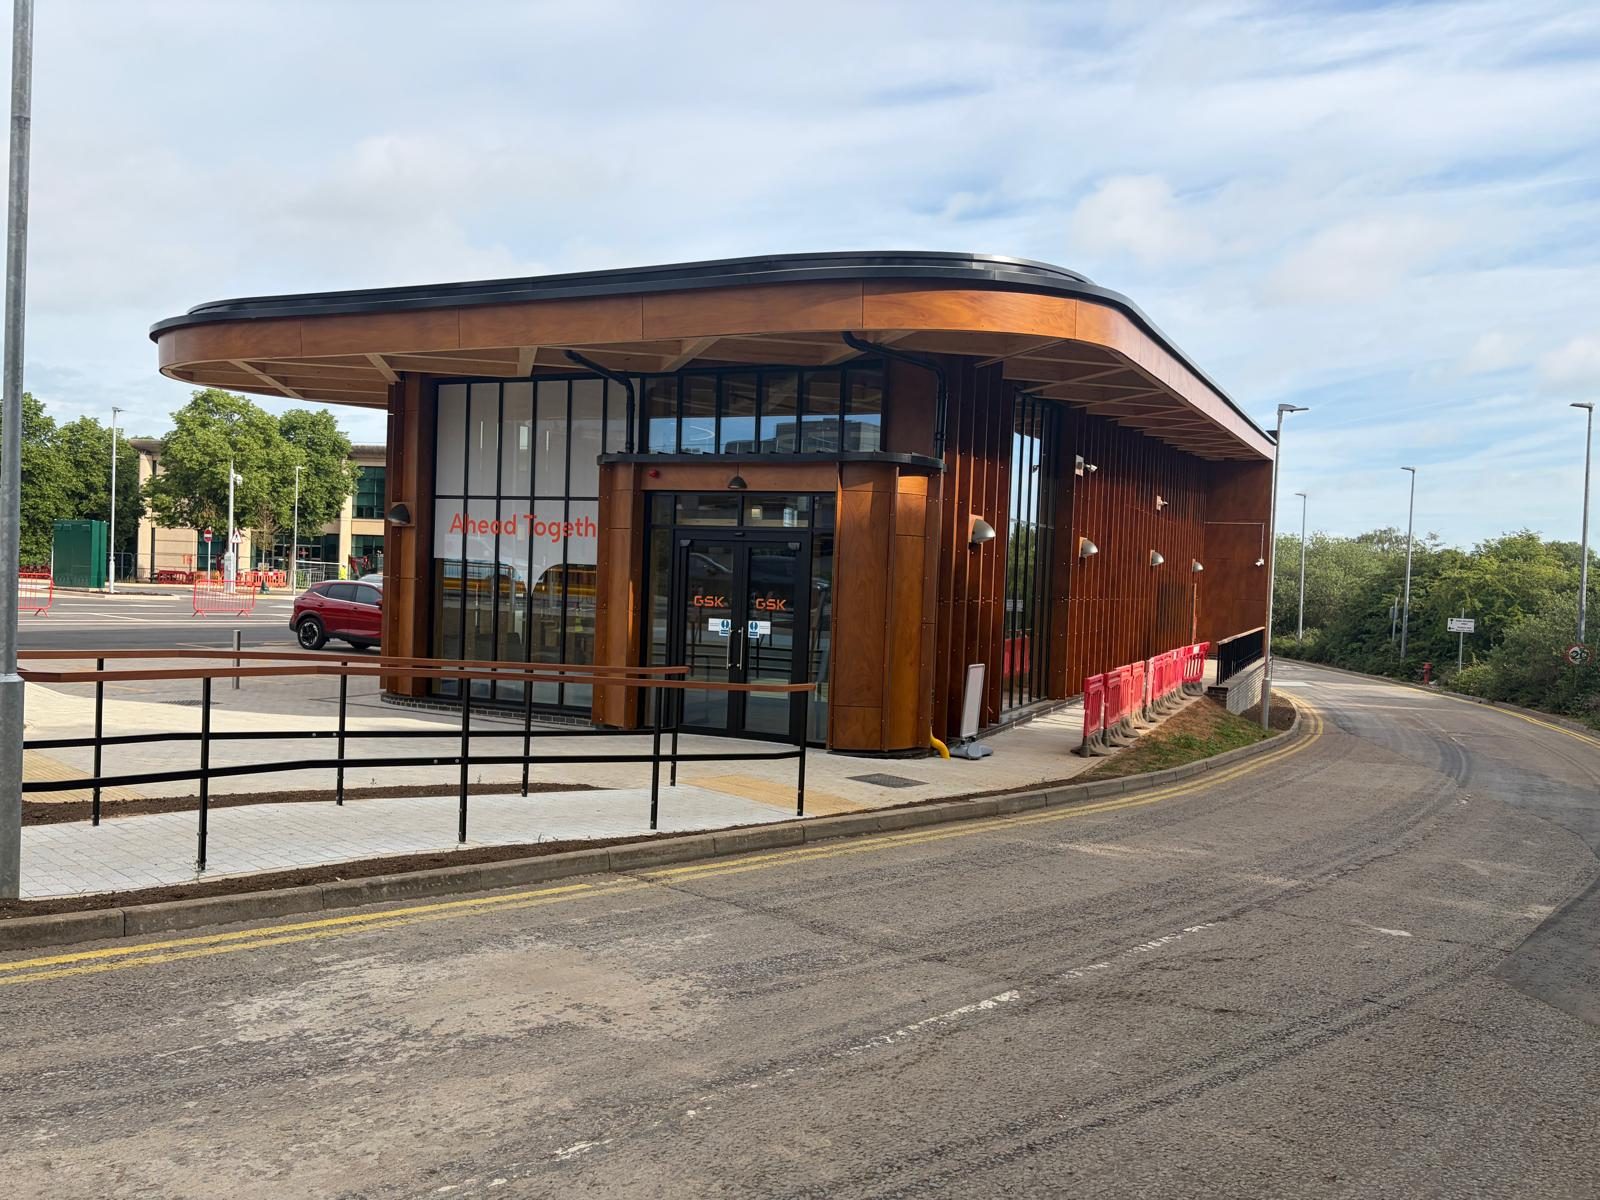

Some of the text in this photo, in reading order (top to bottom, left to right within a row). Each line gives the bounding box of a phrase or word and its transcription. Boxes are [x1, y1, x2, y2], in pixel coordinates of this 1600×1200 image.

[448, 513, 597, 543] Ahead Togeth
[693, 595, 725, 608] GSK
[755, 598, 787, 611] GSK
